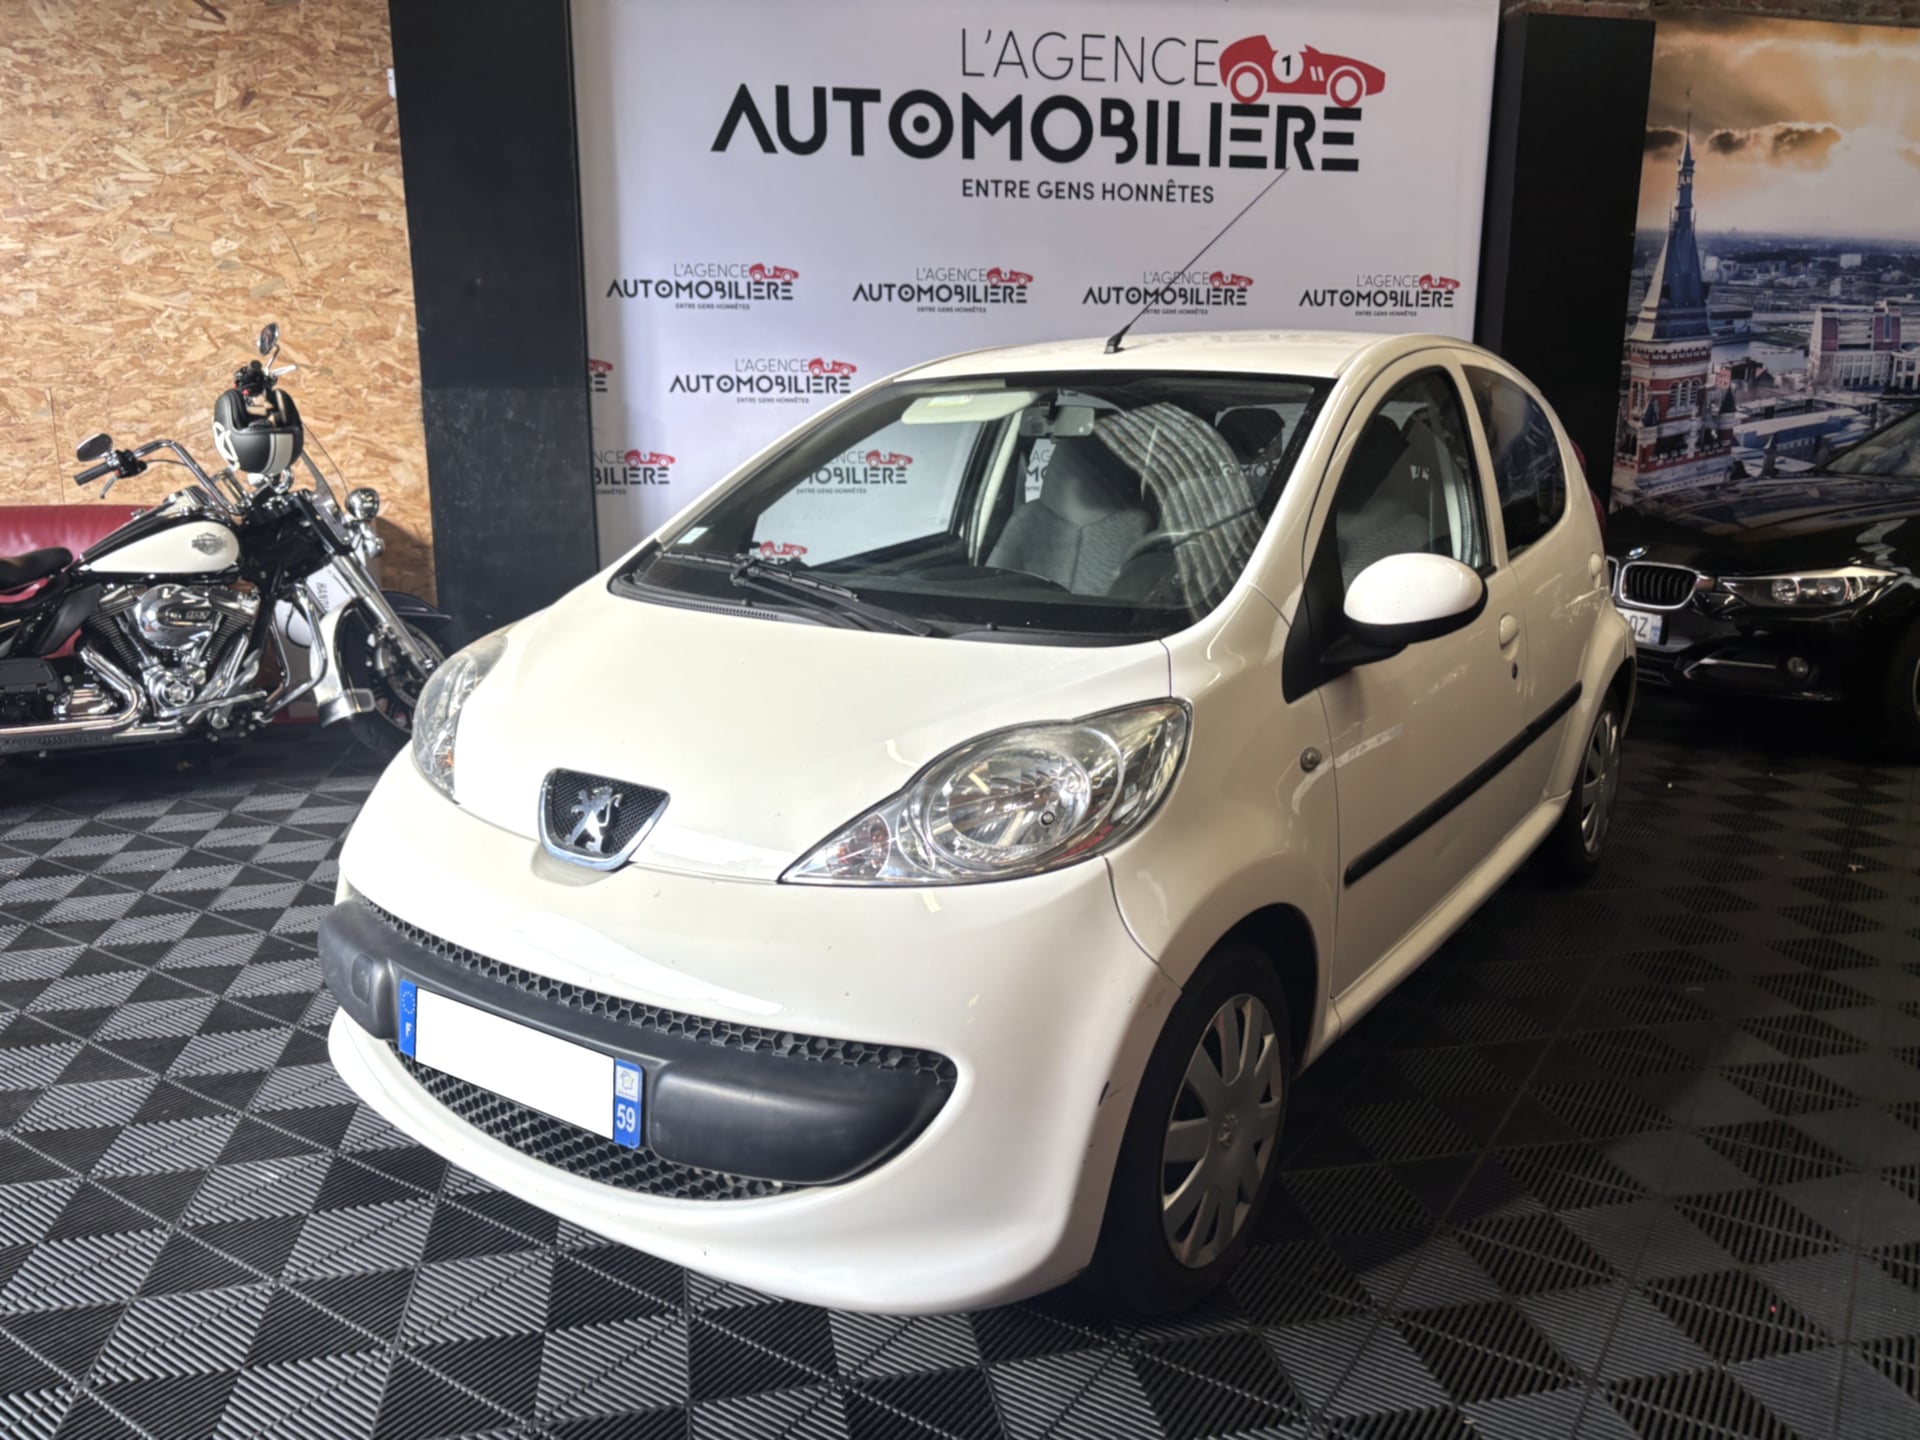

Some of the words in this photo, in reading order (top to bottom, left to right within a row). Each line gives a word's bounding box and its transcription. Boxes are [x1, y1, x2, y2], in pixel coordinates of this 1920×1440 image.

[961, 27, 1219, 87] L'AGENCE
[1281, 55, 1293, 77] 1
[710, 82, 1362, 172] AUTOMOBILIERE
[961, 178, 1031, 199] ENTRE
[1036, 180, 1095, 201] GENS
[1102, 178, 1215, 205] HONNÊTES
[606, 278, 794, 301] AUTOMOBILIERE
[852, 283, 1028, 304] AUTOMOBILIERE
[1082, 286, 1248, 306] AUTOMOBILIERE
[1298, 289, 1455, 309] AUTOMOBILIERE
[669, 374, 852, 395] AUTOMOBILIERE
[405, 1021, 413, 1038] F
[615, 1103, 637, 1134] 59
